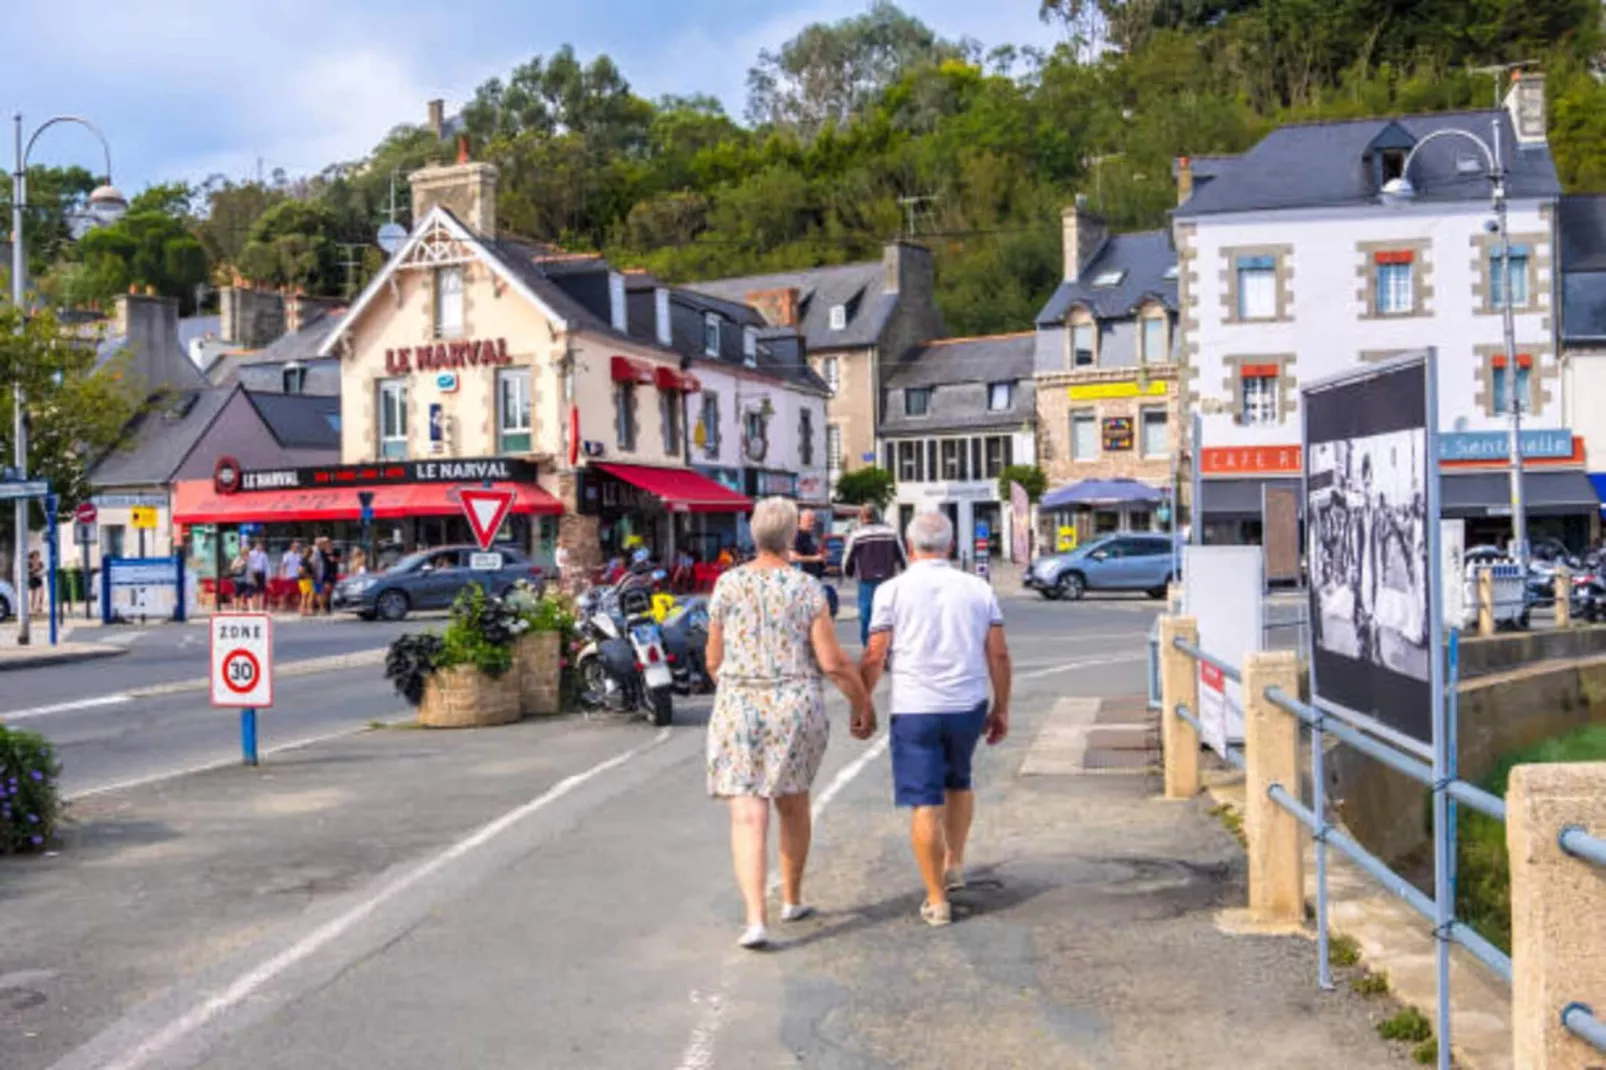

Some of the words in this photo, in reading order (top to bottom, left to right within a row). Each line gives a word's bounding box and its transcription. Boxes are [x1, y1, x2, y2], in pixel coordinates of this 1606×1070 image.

[386, 348, 411, 375] LE
[416, 338, 512, 371] NARVAL
[416, 463, 436, 479] LE
[440, 461, 510, 479] NARVAL
[220, 625, 261, 639] ZONE
[230, 662, 253, 680] 30
